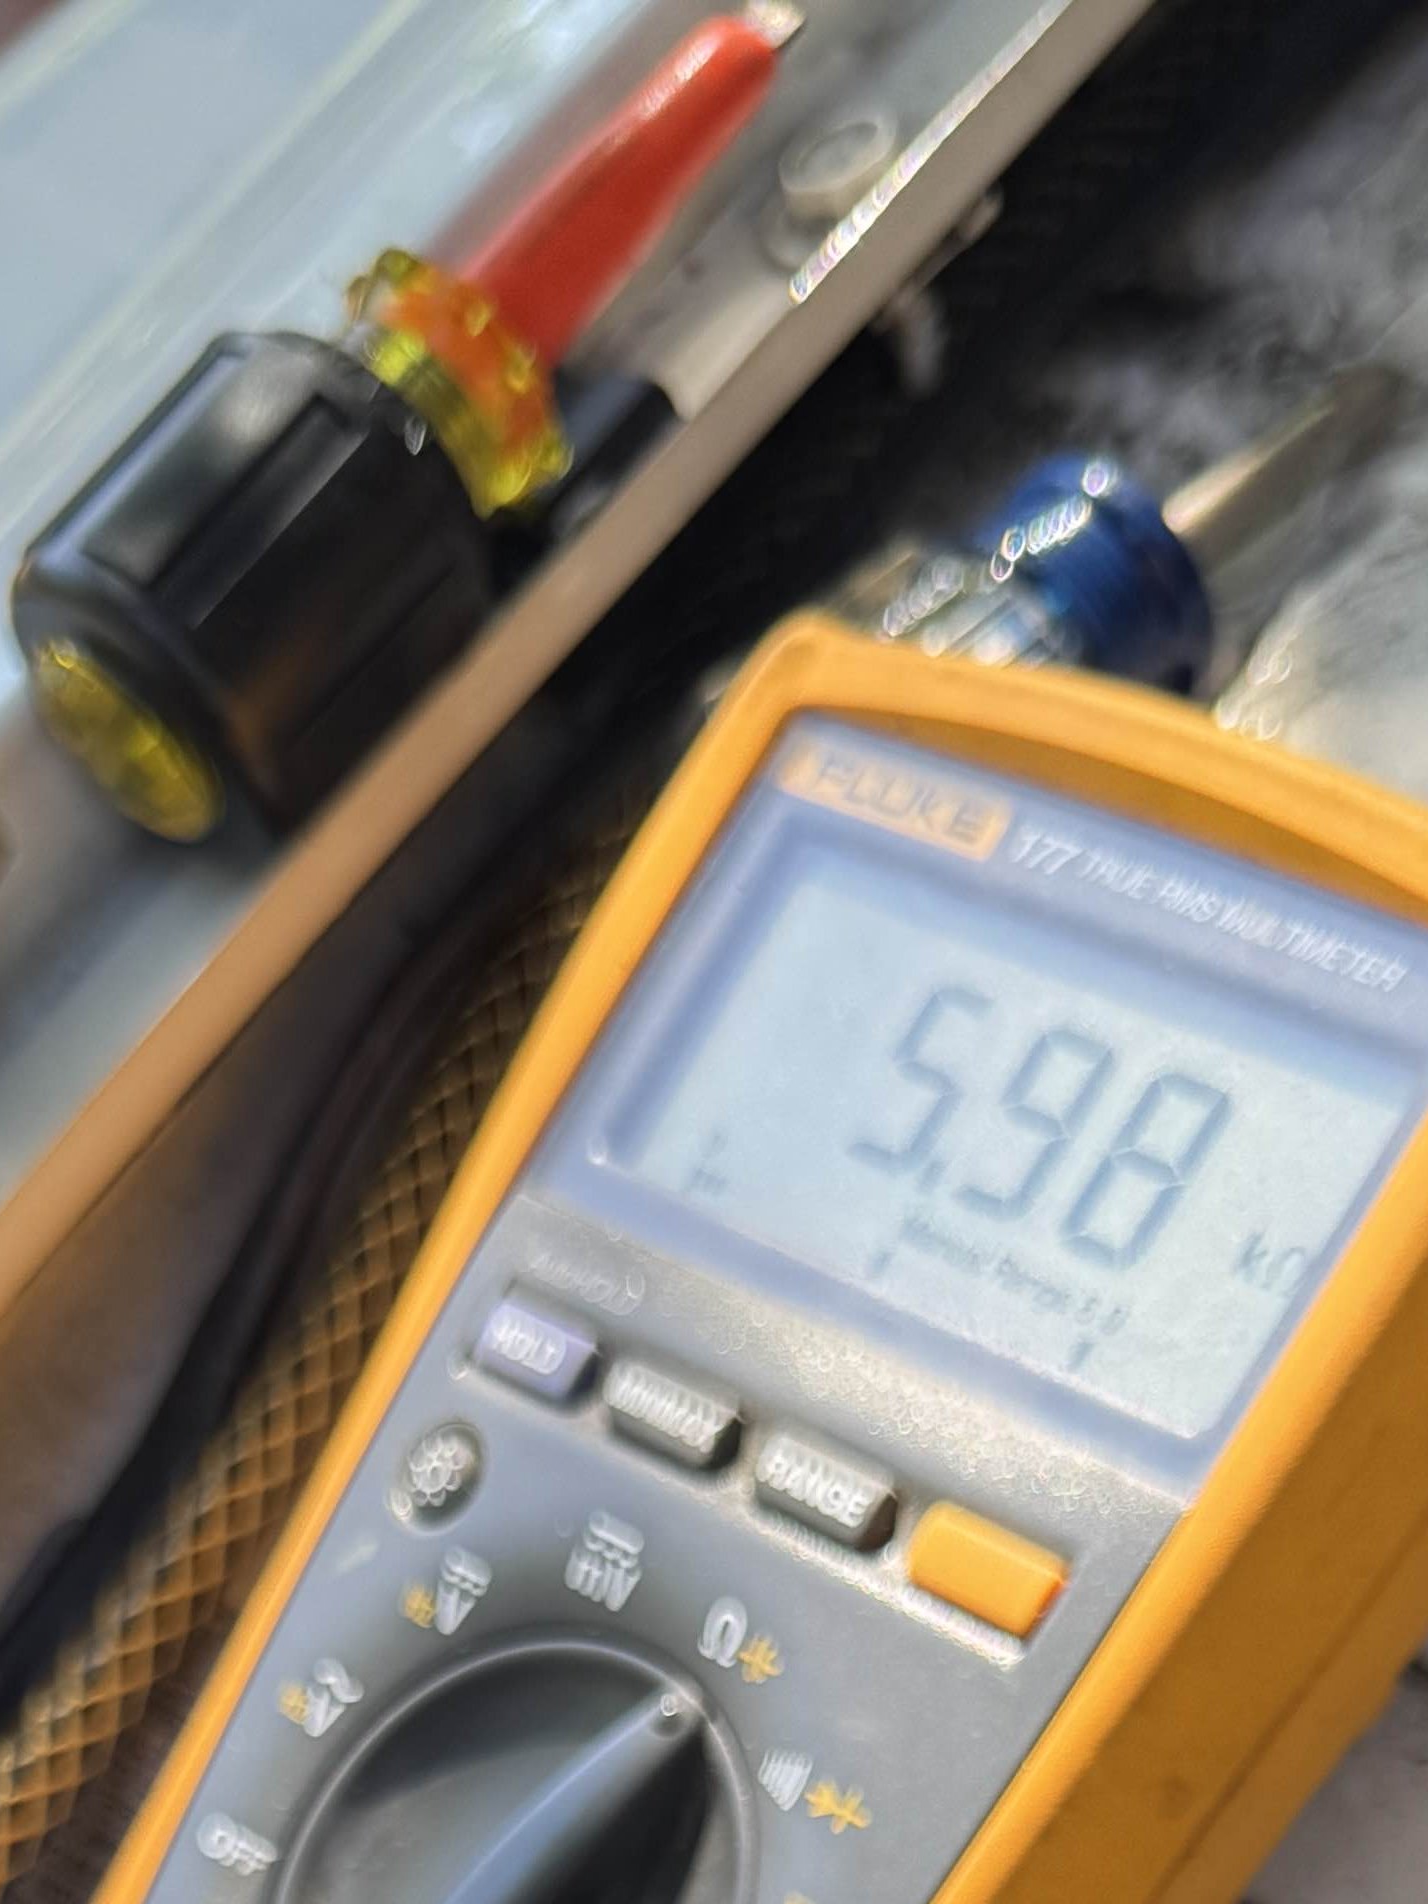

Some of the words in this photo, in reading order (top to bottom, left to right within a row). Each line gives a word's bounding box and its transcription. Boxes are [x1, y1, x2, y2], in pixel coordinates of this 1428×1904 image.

[813, 748, 989, 843] FLUKE
[1014, 830, 1081, 881] 177
[1078, 851, 1155, 902] TRUE
[1216, 898, 1407, 995] MULTIMETER
[845, 986, 1236, 1272] 5.98
[760, 1443, 879, 1528] RANGE
